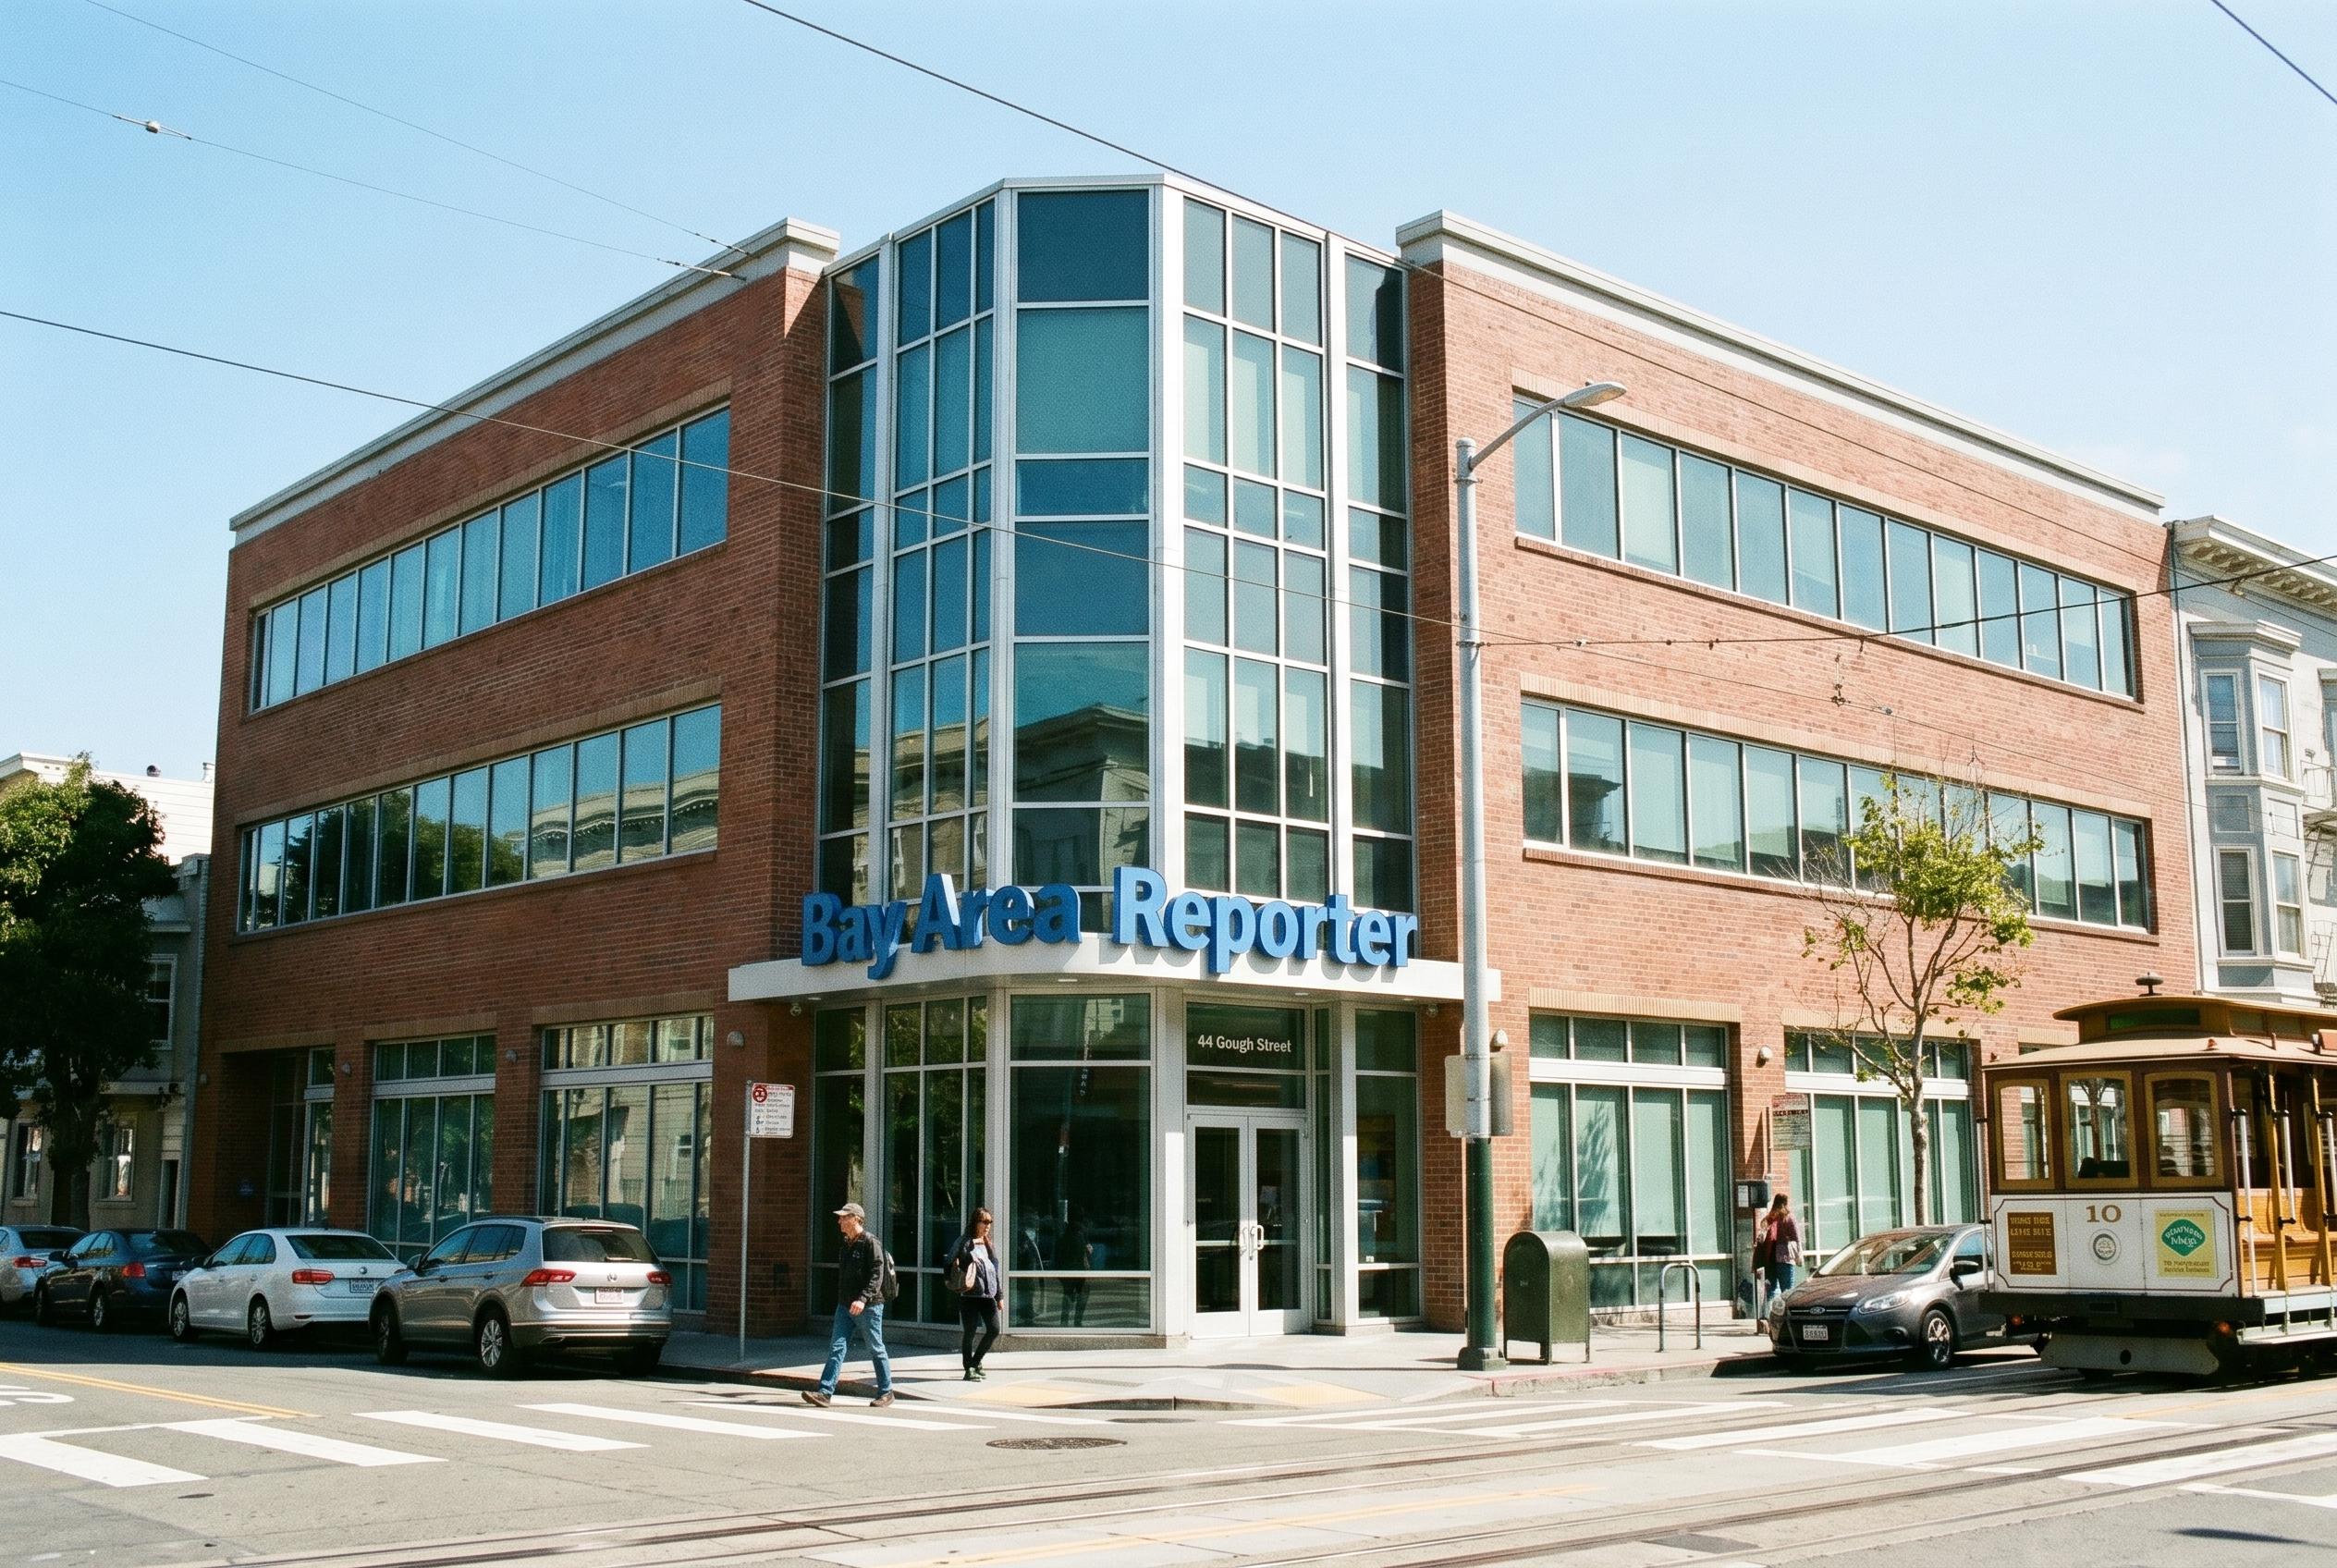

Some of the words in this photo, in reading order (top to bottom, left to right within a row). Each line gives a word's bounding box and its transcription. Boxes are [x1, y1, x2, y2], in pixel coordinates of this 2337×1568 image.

[801, 891, 907, 980] Bay
[911, 873, 1083, 954] Area
[1113, 866, 1418, 974] Reporter
[1197, 1034, 1214, 1048] 44
[1216, 1035, 1254, 1054] Gough
[1256, 1037, 1292, 1053] Street
[2086, 1204, 2122, 1223] 10
